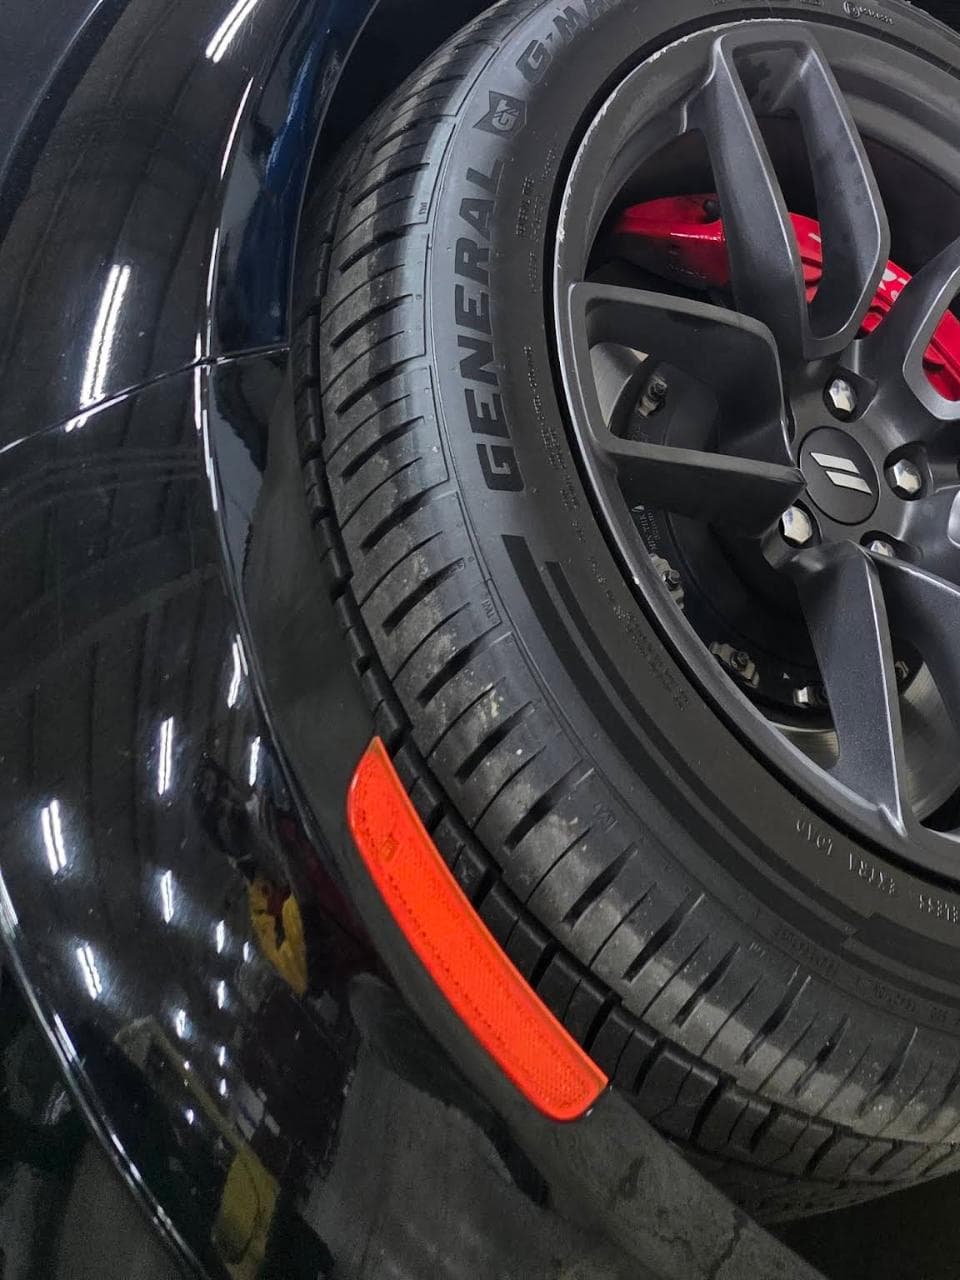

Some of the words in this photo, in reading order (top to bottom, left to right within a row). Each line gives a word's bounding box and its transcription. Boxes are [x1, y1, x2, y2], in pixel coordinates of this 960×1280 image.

[455, 159, 524, 492] GENERAL
[795, 818, 834, 857] LOAD
[848, 852, 897, 897] EXTRA
